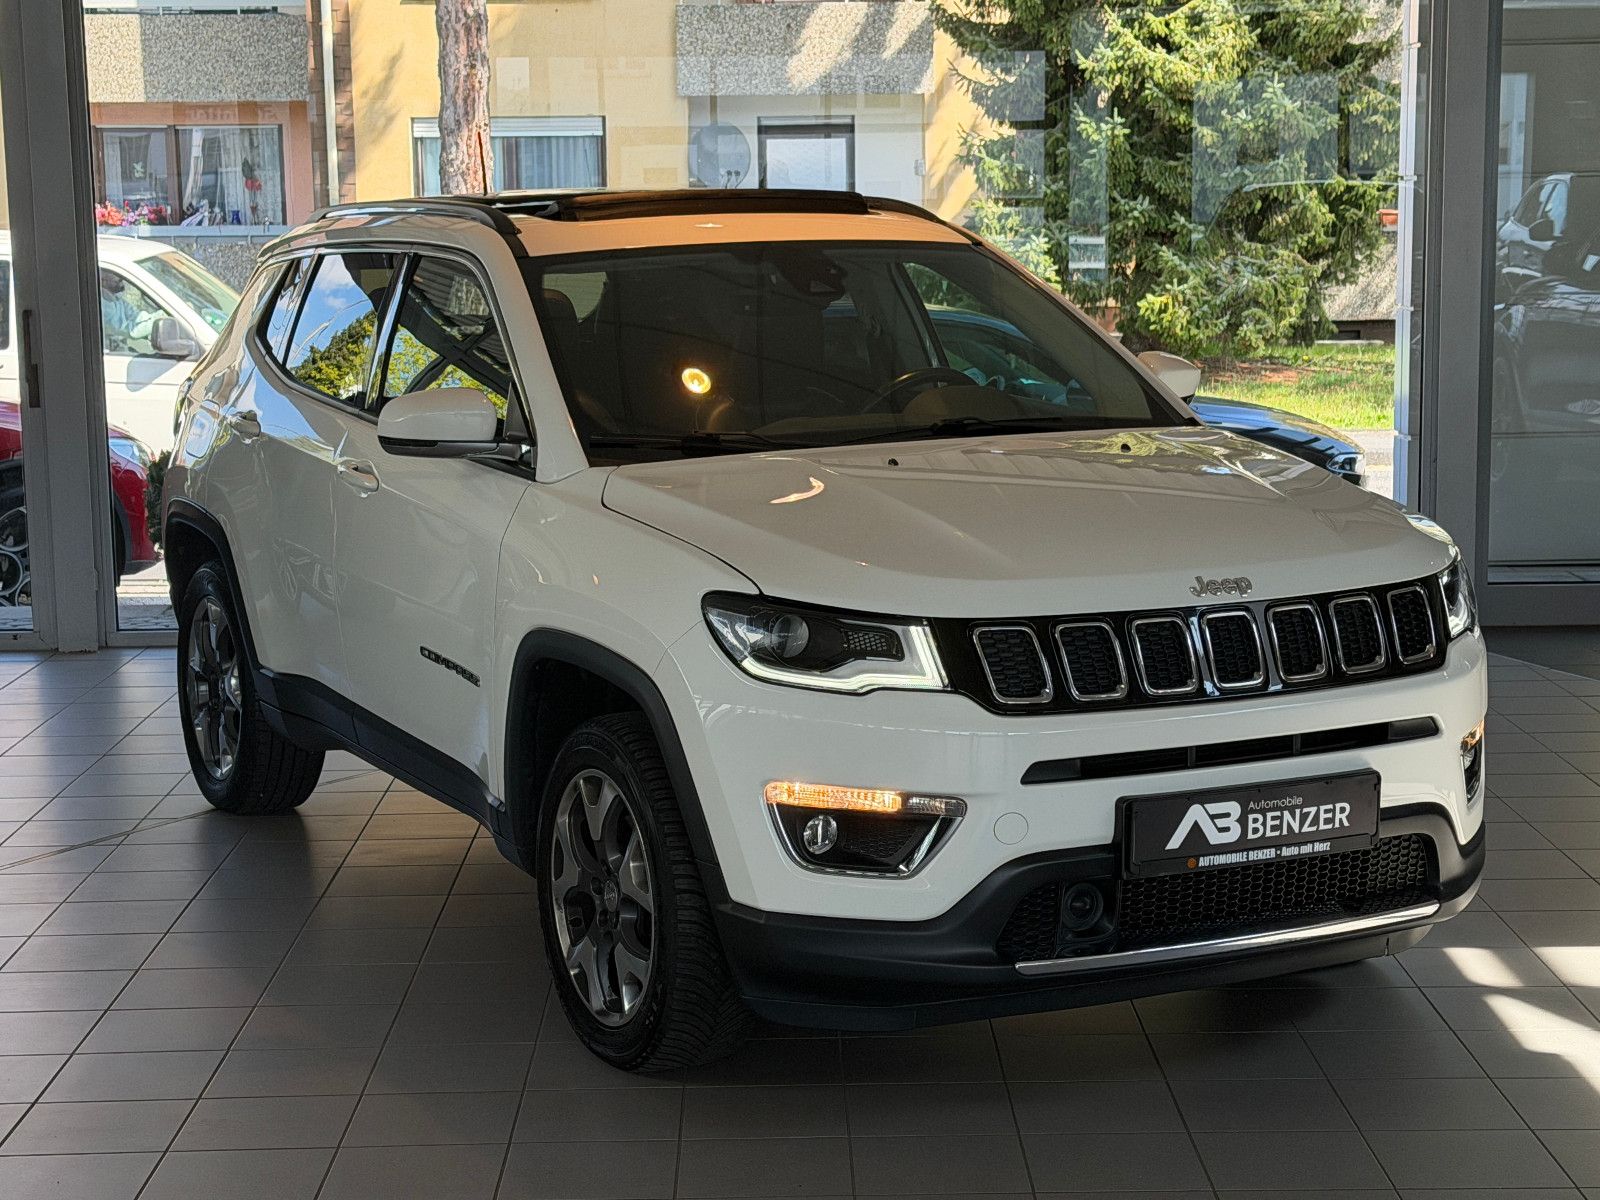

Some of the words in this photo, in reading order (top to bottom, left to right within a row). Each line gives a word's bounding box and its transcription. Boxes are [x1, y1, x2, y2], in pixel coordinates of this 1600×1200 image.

[1189, 575, 1253, 597] Jeep
[419, 645, 481, 688] COMPASS
[1247, 796, 1303, 811] Automobile
[1246, 802, 1351, 840] BENZER
[1198, 851, 1248, 867] AUTOMOBILE
[1248, 848, 1276, 861] BENZER
[1281, 846, 1299, 857] Auto
[1300, 843, 1313, 854] mit
[1313, 841, 1331, 852] Herz
